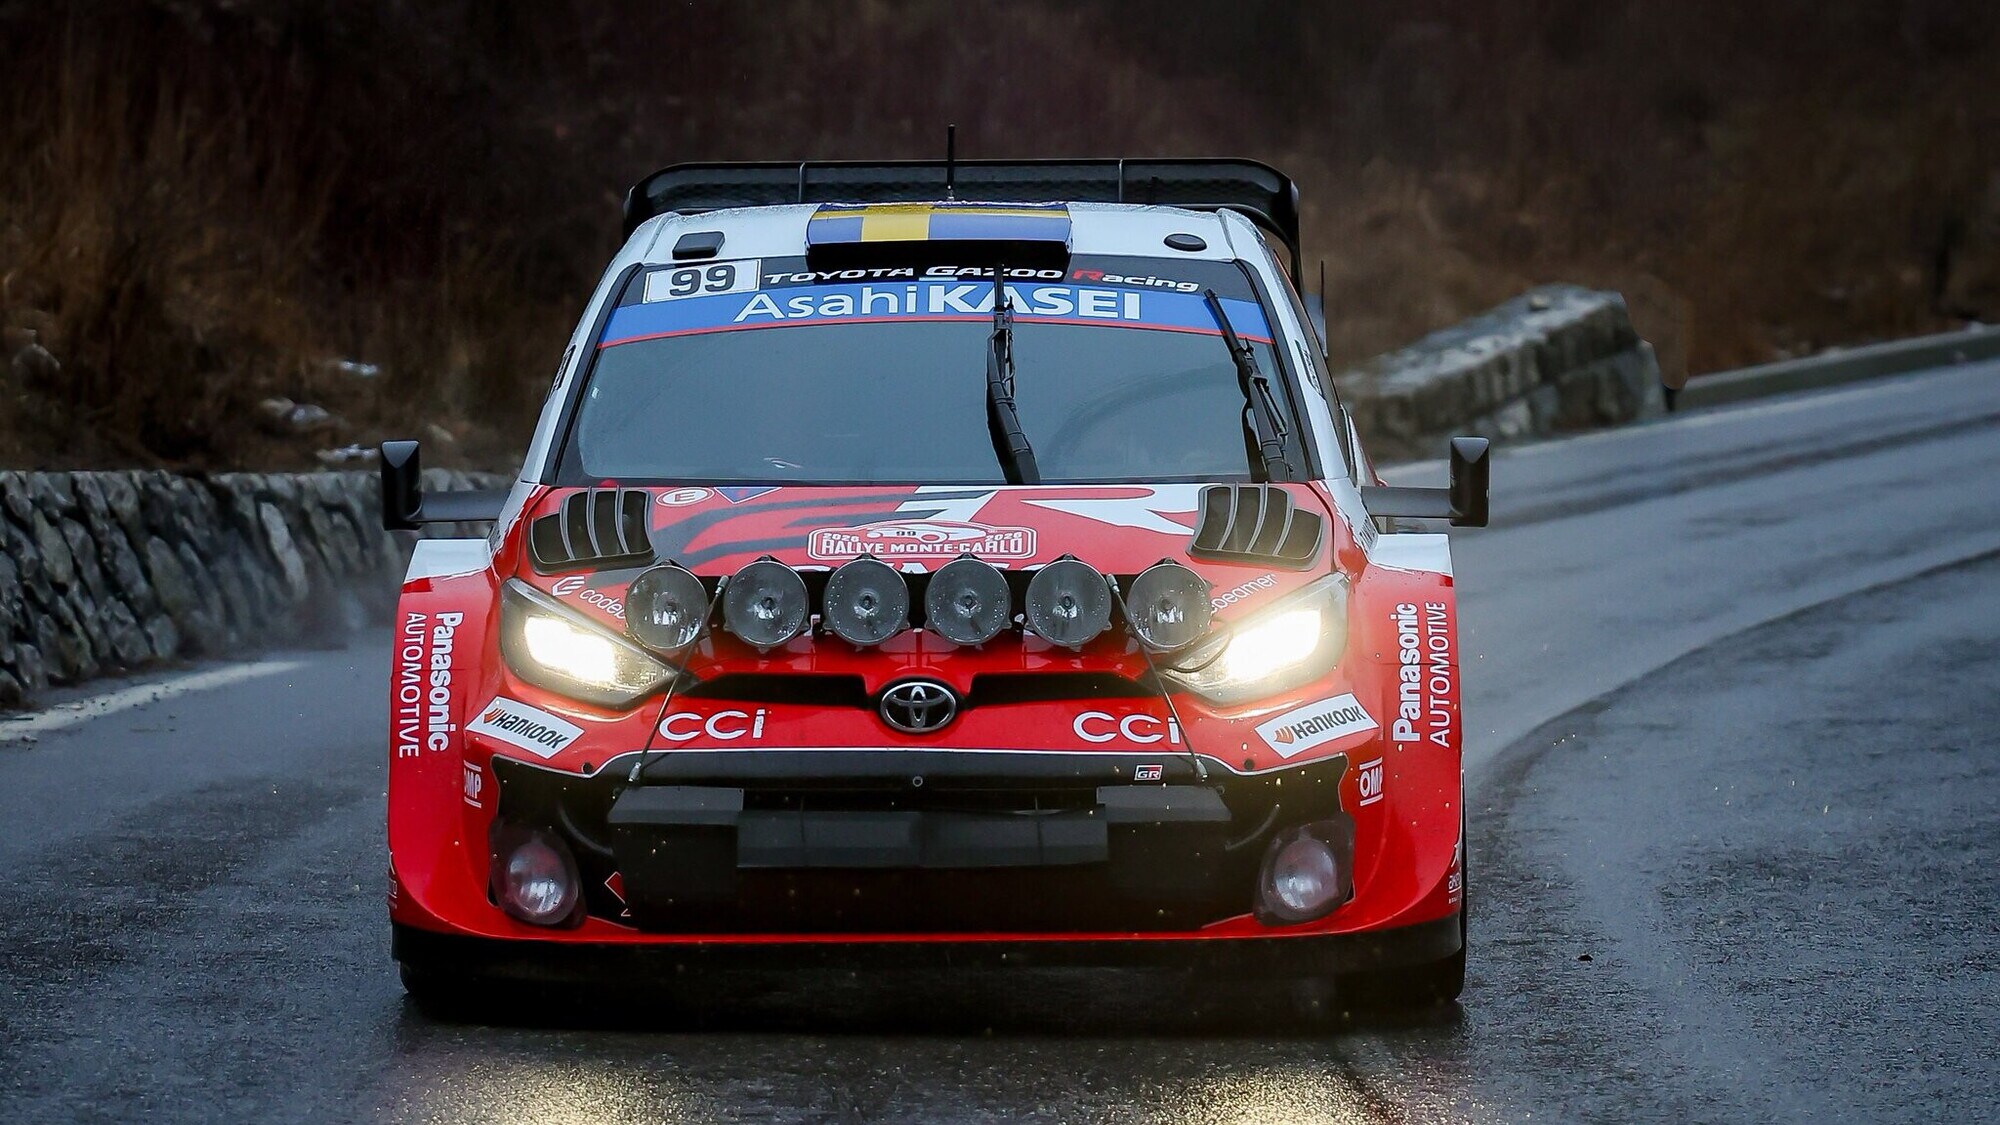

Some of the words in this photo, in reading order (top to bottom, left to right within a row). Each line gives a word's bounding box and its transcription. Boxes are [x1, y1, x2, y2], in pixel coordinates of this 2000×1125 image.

[669, 264, 736, 296] 99
[764, 267, 914, 284] TOYOTA
[925, 265, 1063, 279] GAZOO
[1072, 267, 1199, 293] Racing
[821, 539, 884, 554] RALLYE
[890, 538, 1024, 554] MONTE-CARLO
[398, 612, 428, 759] AUTOMOTIVE
[427, 612, 464, 752] Panasonic
[1390, 602, 1421, 742] Panasonic
[1428, 601, 1450, 748] AUTOMOTIVE
[1137, 769, 1160, 779] GR
